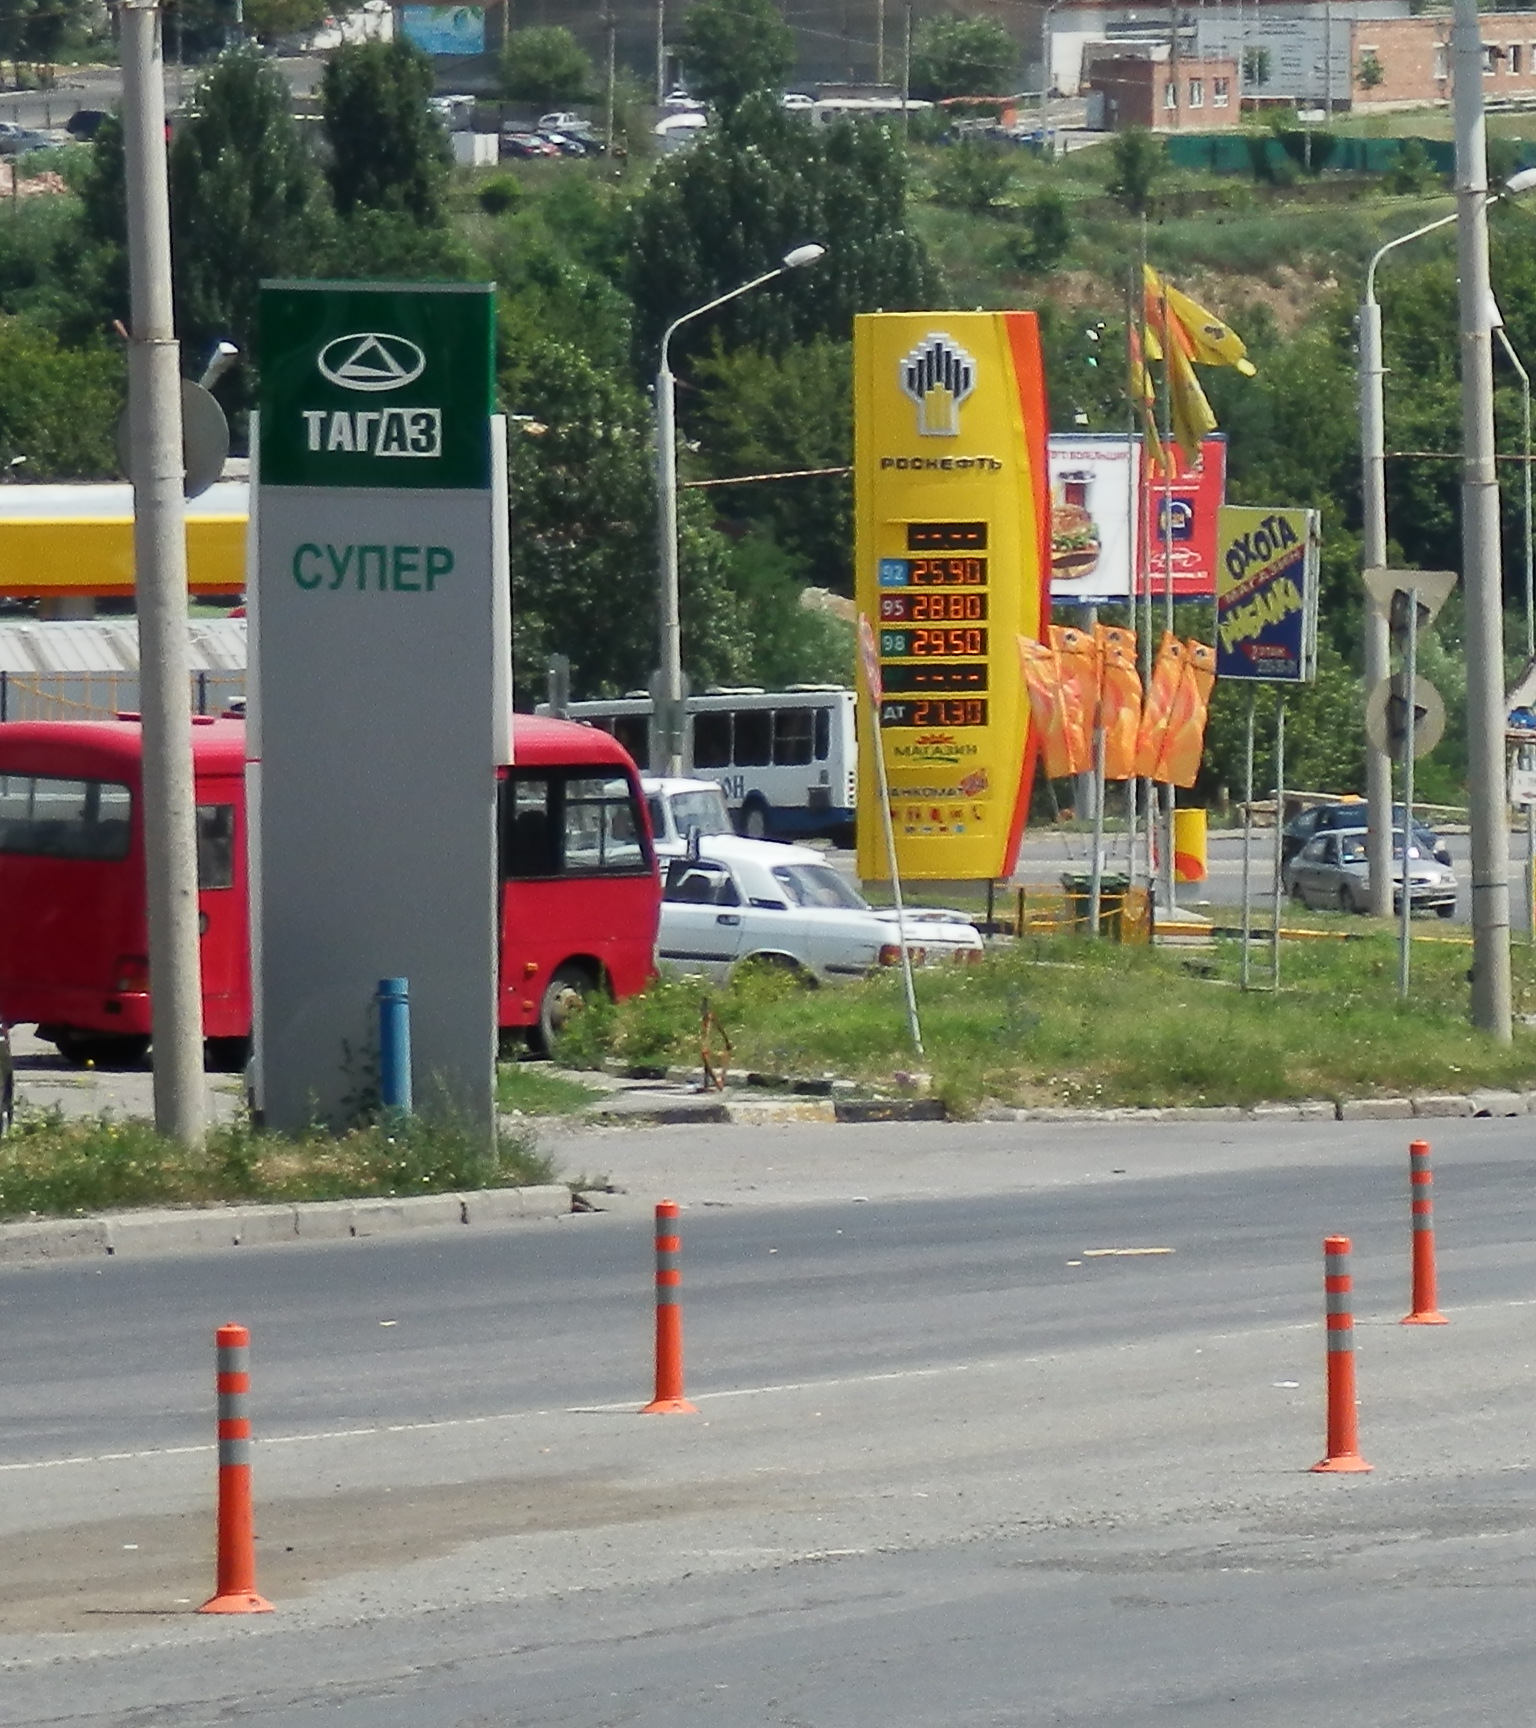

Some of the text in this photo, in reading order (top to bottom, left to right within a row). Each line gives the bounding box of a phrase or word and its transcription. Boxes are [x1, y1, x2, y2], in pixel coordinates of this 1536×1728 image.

[302, 407, 442, 456] ТАГАЗ
[880, 455, 1002, 472] РОСНЕФТЬ
[1225, 514, 1299, 581] ОХОТА
[291, 542, 456, 592] СУПЕР
[881, 564, 904, 581] 92
[882, 599, 904, 616] 95
[882, 634, 906, 651] 98
[893, 744, 978, 757] МАГАЗИН
[880, 785, 964, 798] АНКОМАТ
